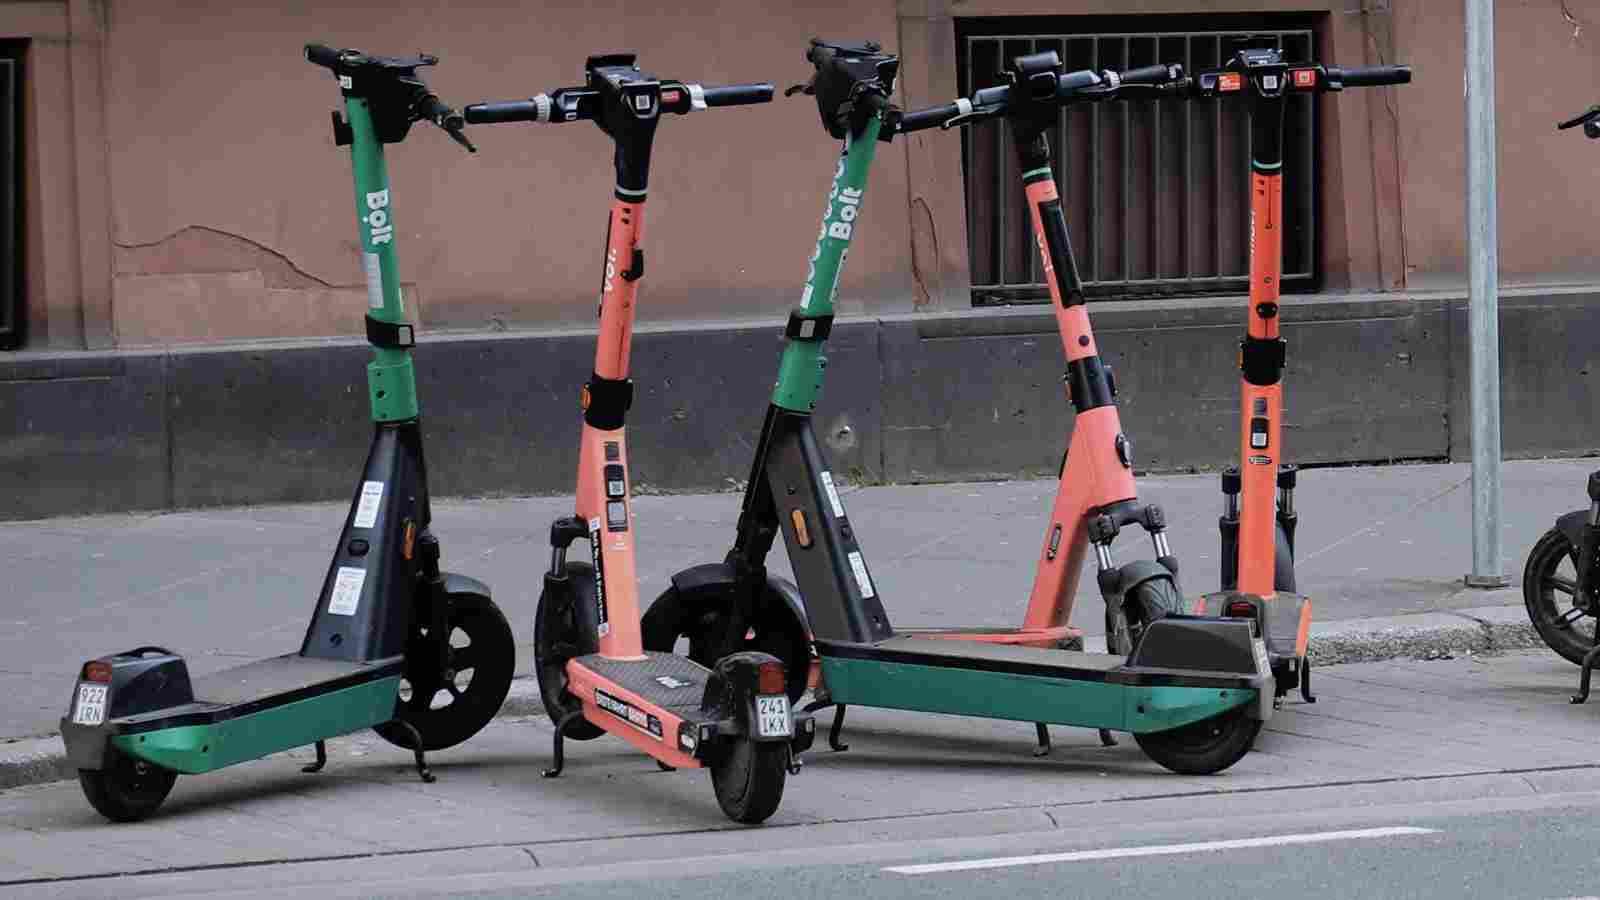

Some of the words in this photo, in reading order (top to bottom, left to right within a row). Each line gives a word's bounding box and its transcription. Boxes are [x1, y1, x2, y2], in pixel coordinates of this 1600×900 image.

[364, 188, 393, 245] Bolt
[828, 187, 863, 240] Bolt
[81, 687, 104, 704] 922
[760, 699, 784, 714] 241
